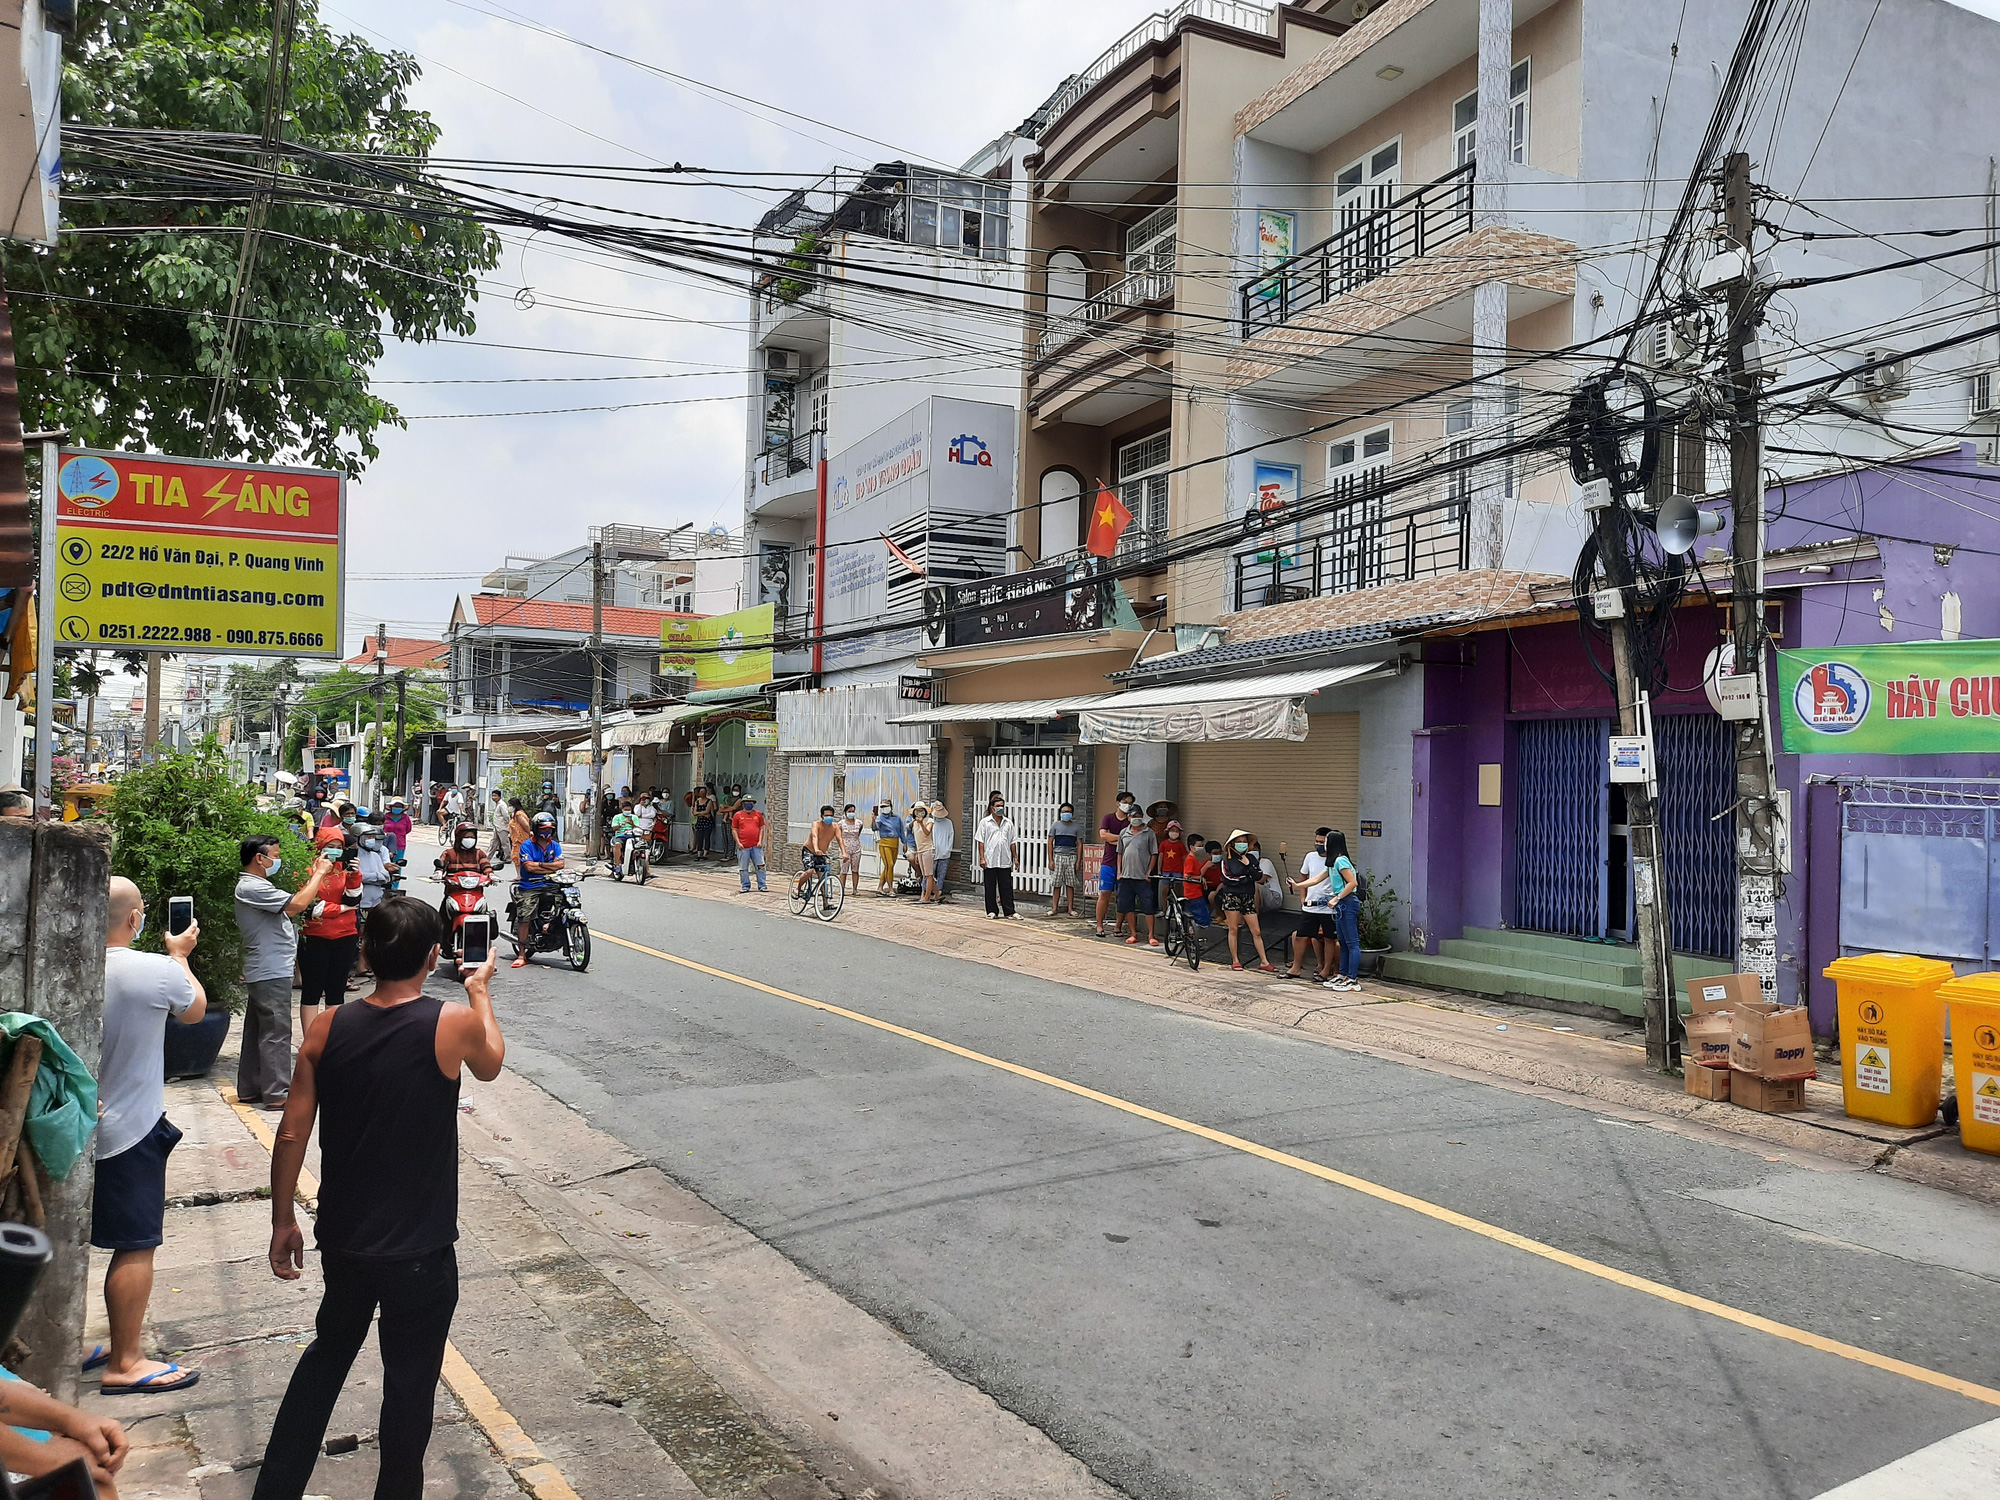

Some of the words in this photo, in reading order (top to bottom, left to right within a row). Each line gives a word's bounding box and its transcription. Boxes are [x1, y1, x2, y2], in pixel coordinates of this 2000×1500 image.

[129, 473, 189, 508] TIA
[66, 507, 111, 518] ELECTRIC
[101, 544, 134, 560] 22/2
[140, 543, 158, 561] Hồ
[164, 548, 191, 564] Văn
[195, 550, 224, 568] Đại,
[228, 553, 240, 567] P.
[245, 553, 289, 572] Quang
[294, 556, 324, 572] Vinh
[101, 581, 324, 607] pdt@dntntiasang.com
[99, 624, 211, 642] 0251.2222.988
[226, 629, 324, 647] 090.875.6666
[902, 686, 924, 698] TWO
[923, 689, 931, 699] B
[1887, 673, 1940, 718] HÃY
[1813, 713, 1835, 722] BIÊN
[1084, 861, 1091, 873] XE
[1774, 1046, 1806, 1060] Roppy
